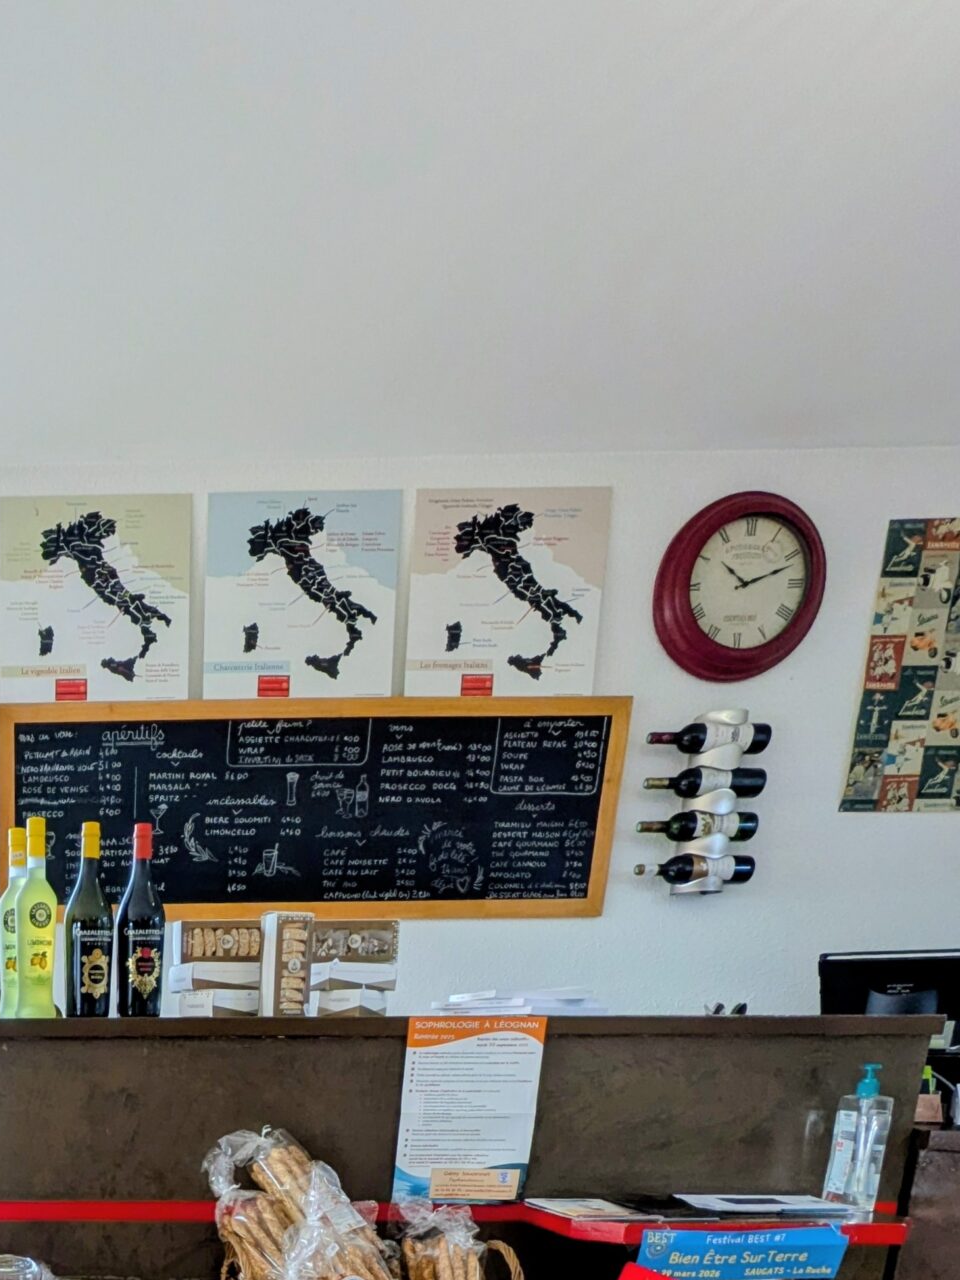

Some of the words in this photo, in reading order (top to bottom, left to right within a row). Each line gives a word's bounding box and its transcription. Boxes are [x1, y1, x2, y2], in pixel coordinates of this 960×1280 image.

[238, 720, 269, 736] petite
[102, 723, 165, 751] apéritifs
[239, 736, 281, 744] ASSIETTE
[503, 740, 538, 748] PLATEAU
[542, 740, 567, 748] REPAS
[156, 749, 204, 759] cocktails
[238, 747, 265, 755] WRAP
[381, 755, 434, 764] LAMBRUSCO
[502, 752, 528, 760] SOUPE
[149, 772, 185, 780] MARTINI
[189, 772, 218, 780] ROYAL
[380, 769, 404, 777] PETIT
[22, 775, 70, 784] LAMBRUSCO
[499, 775, 523, 783] PASTA
[148, 783, 191, 791] MARSALA
[206, 795, 277, 806] inclassables
[514, 799, 556, 811] desserts
[22, 810, 65, 819] PROSECCO
[234, 816, 271, 824] DOLOMITI
[205, 828, 257, 836] LIMONCELLO
[492, 831, 529, 839] DESSERT
[415, 1021, 480, 1030] SOPHROLOGIE
[484, 1020, 490, 1028] À
[494, 1020, 539, 1029] LÉOGNAN
[647, 1231, 677, 1244] BEST
[706, 1234, 744, 1245] Festival
[748, 1234, 771, 1244] BEST
[773, 1233, 787, 1243] #7
[669, 1251, 699, 1264] Bien
[703, 1249, 736, 1264] Être
[741, 1251, 766, 1264] Sur
[767, 1250, 808, 1263] Terre
[793, 1266, 804, 1274] La
[805, 1265, 832, 1274] Ruche
